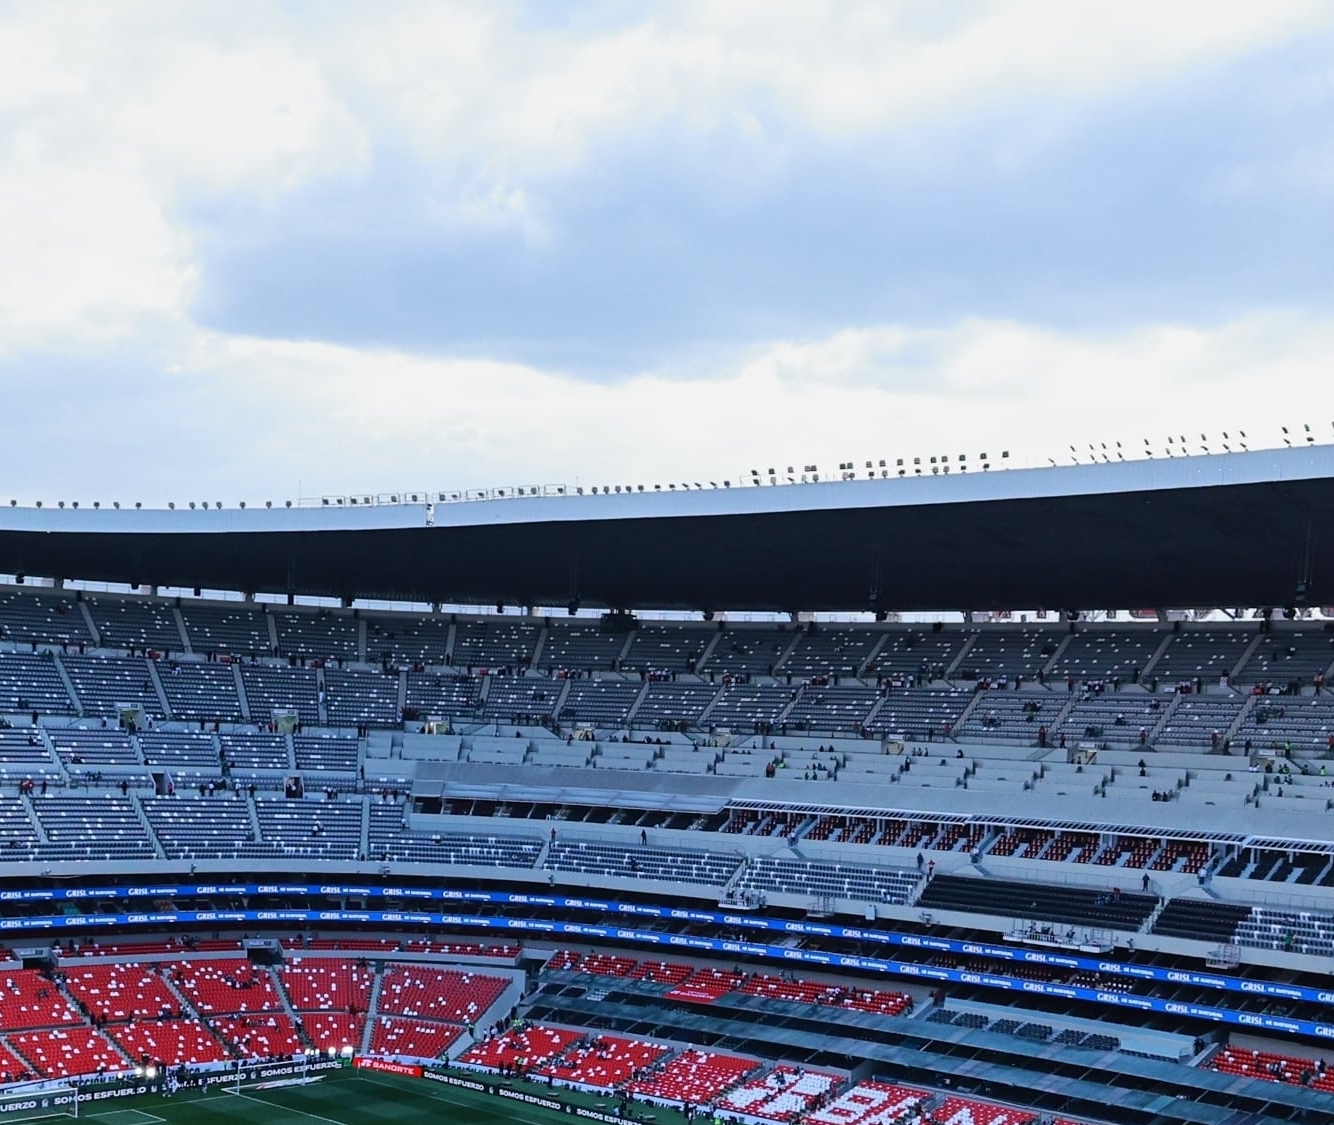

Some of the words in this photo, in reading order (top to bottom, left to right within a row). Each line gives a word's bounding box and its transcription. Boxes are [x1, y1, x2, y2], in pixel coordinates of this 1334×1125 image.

[260, 1068, 292, 1078] SOMOS
[294, 1061, 337, 1073] ESFUERZO
[373, 1062, 414, 1075] BANORTE
[424, 1071, 448, 1083] SOMOS
[449, 1077, 485, 1091] ESFUERZO
[54, 1091, 92, 1105] SOMOS
[499, 1089, 524, 1100] SOMOS
[524, 1095, 561, 1110] ESFUERZO
[576, 1108, 603, 1121] SOMOS
